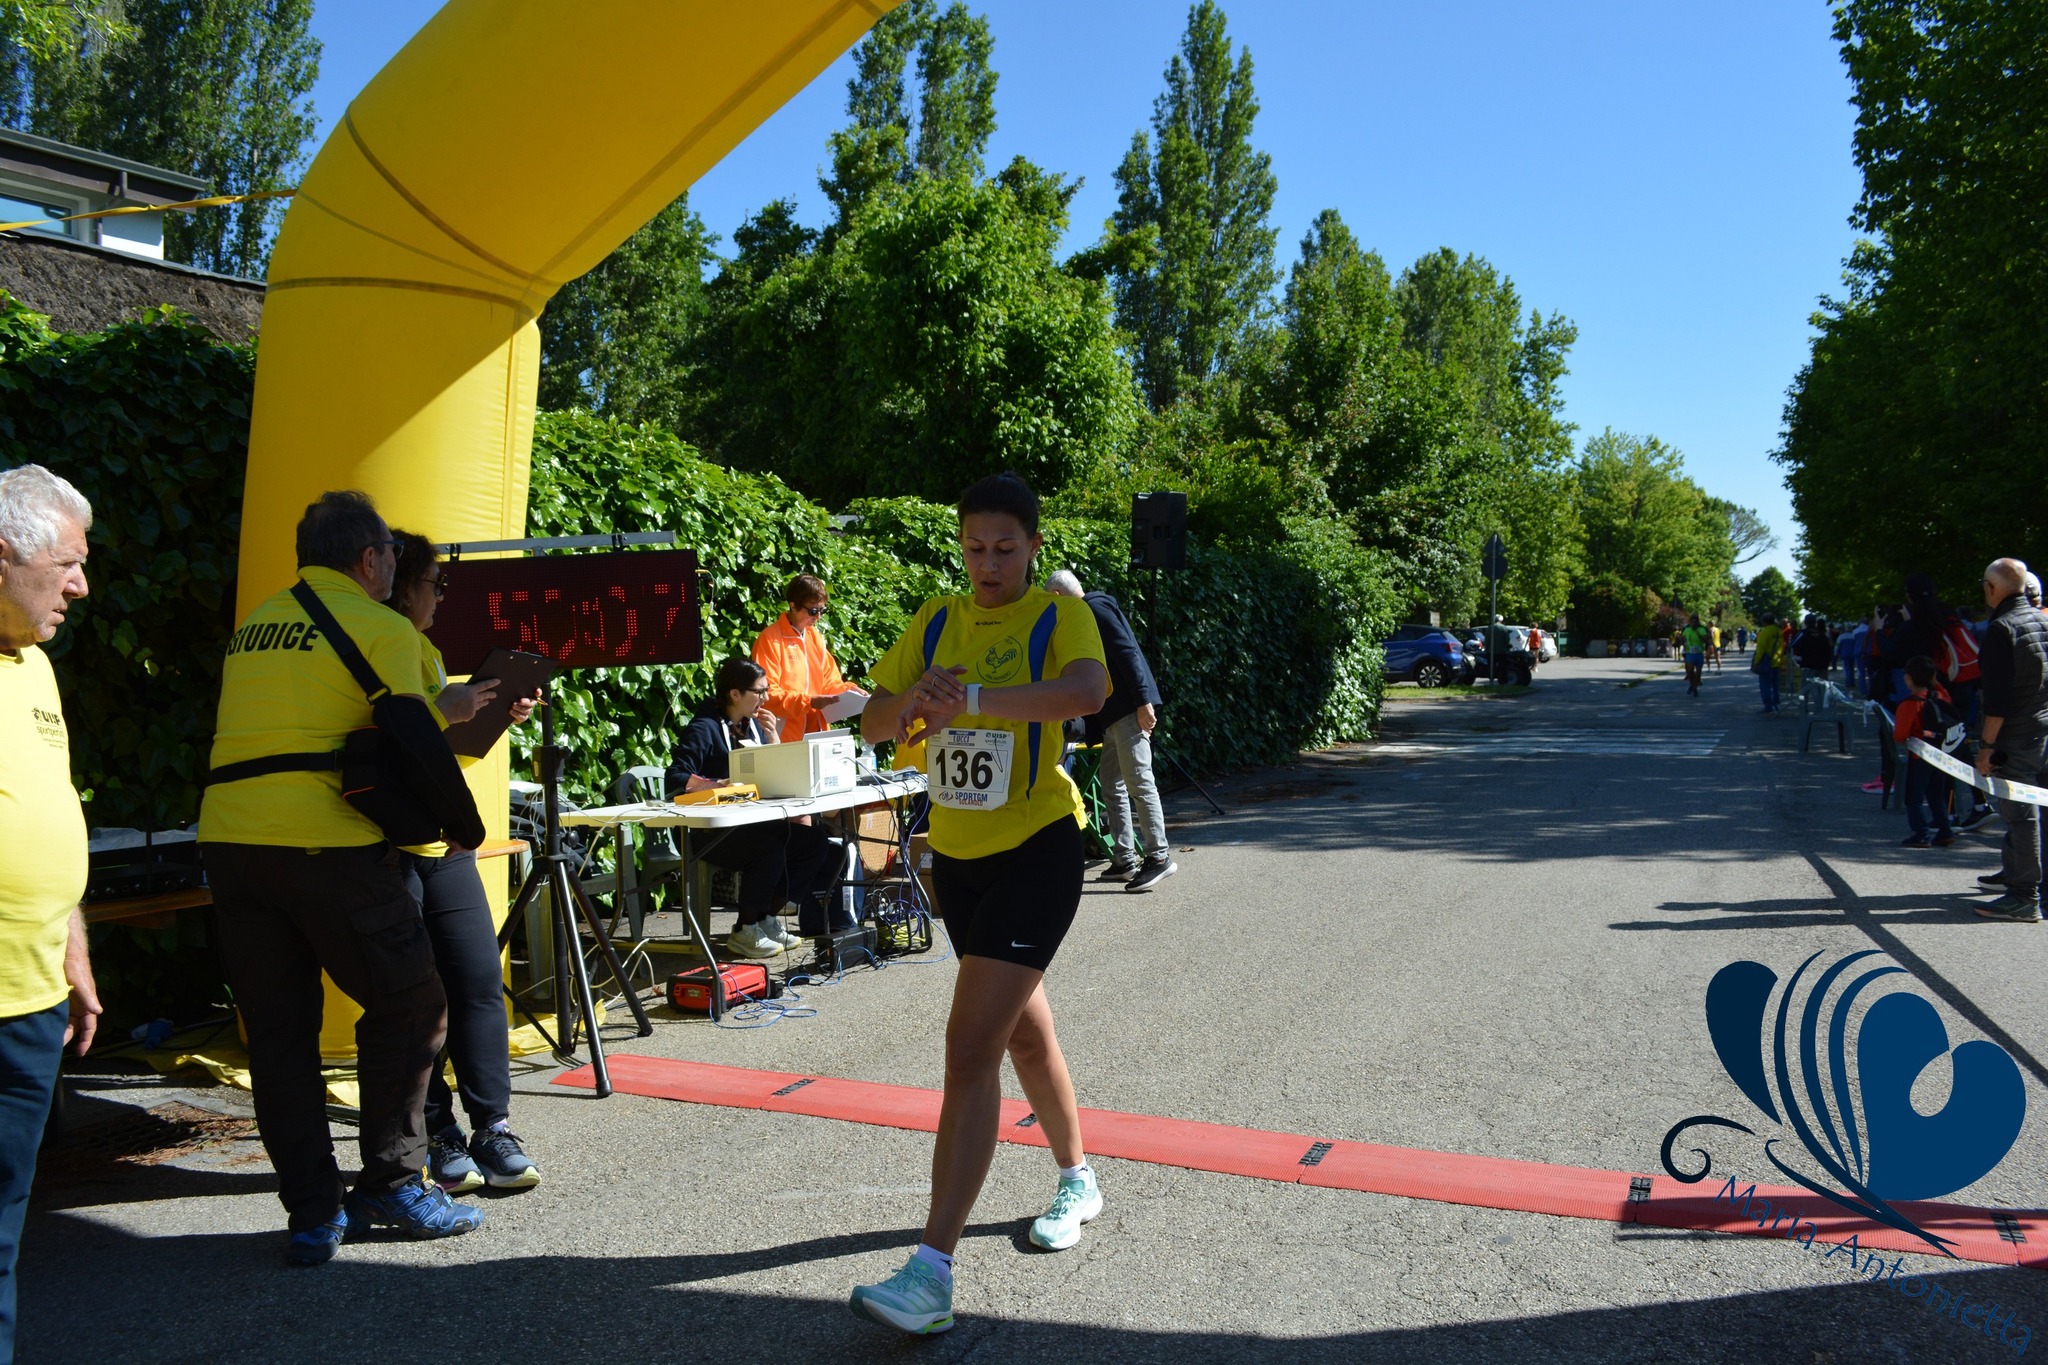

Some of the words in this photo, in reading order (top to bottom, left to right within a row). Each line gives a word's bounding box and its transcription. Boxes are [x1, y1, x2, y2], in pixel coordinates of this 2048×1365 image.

[228, 622, 319, 656] GIUDICE
[1945, 722, 1965, 743] NIKE
[935, 748, 994, 790] 136
[954, 791, 988, 802] SPORTGM
